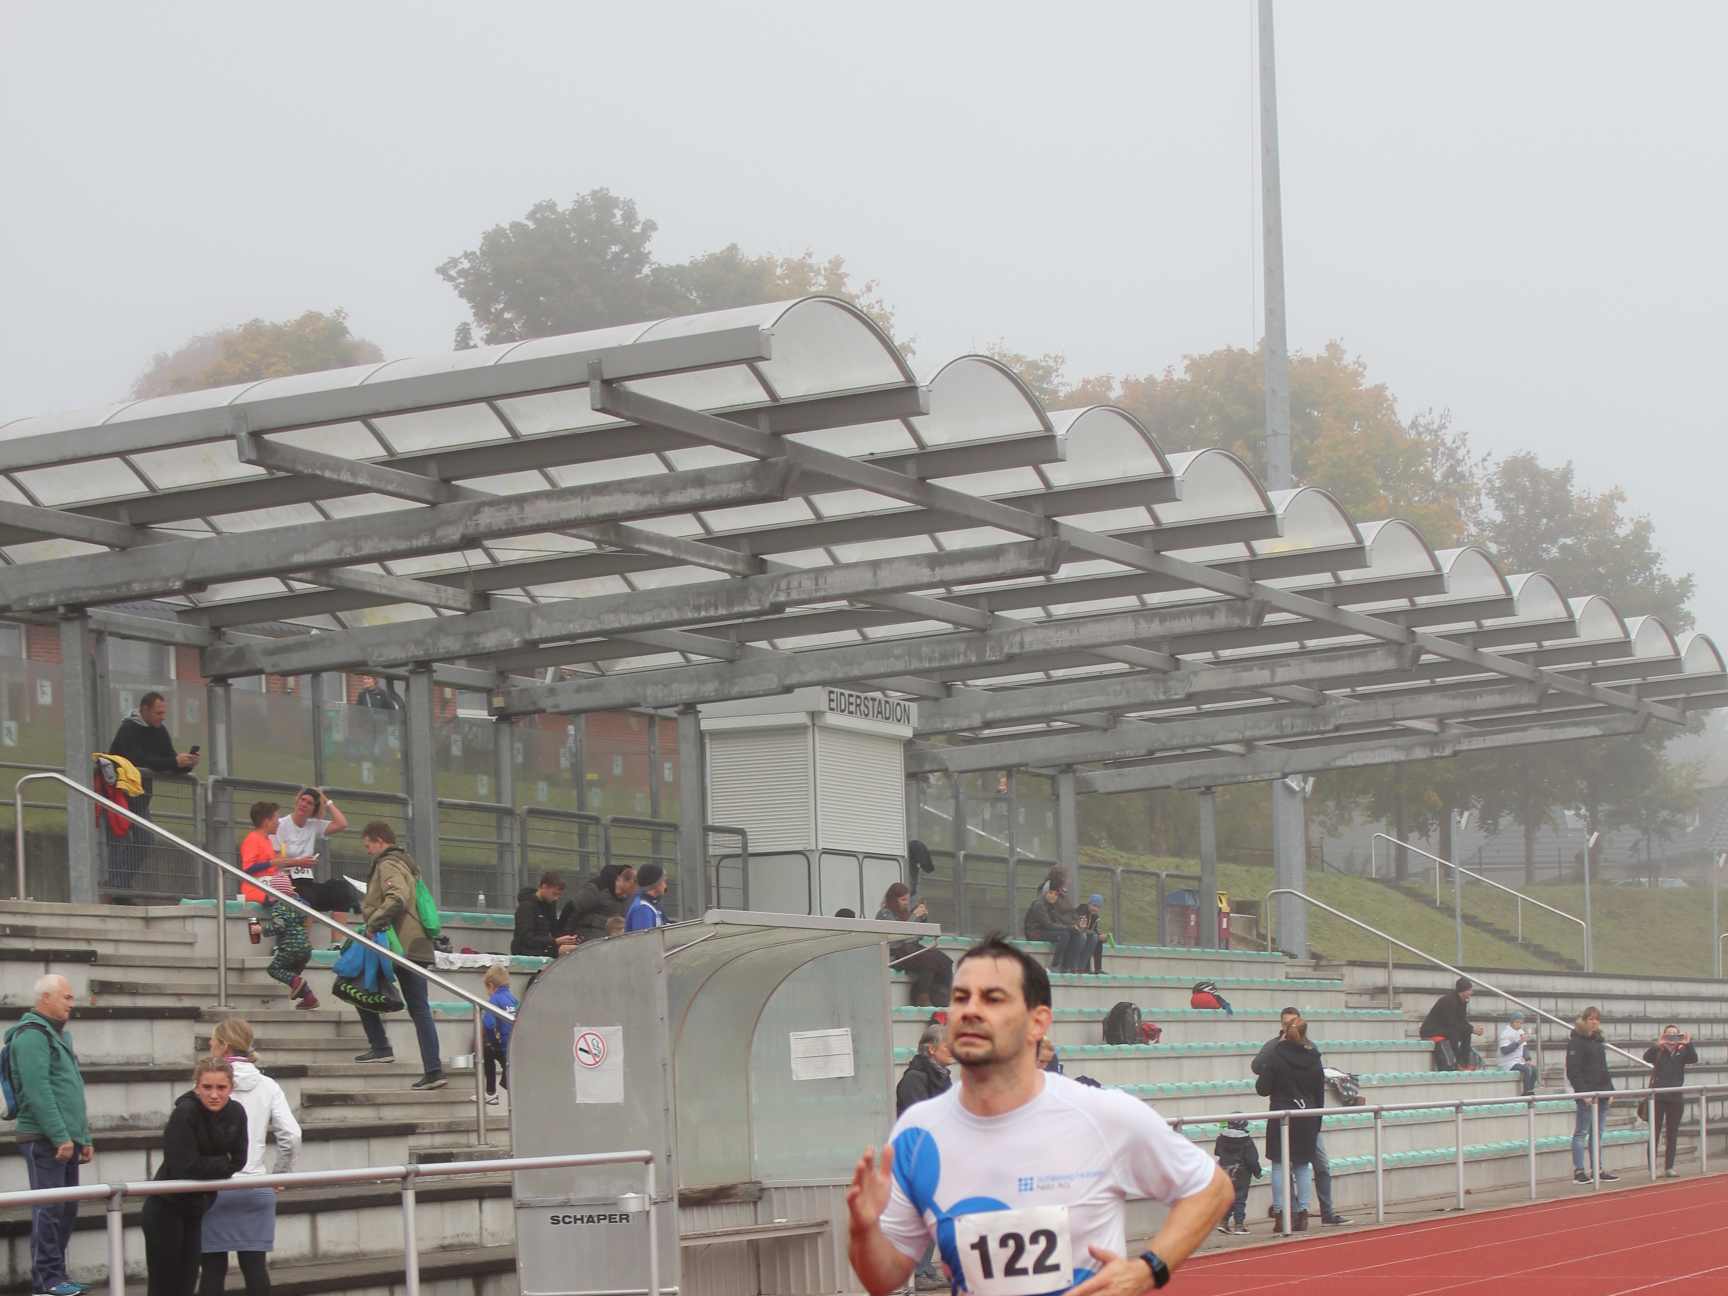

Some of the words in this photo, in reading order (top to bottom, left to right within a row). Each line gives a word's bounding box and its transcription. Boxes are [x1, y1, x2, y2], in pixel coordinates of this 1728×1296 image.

[828, 690, 910, 724] EIDERSTADION
[550, 1213, 630, 1225] SCHÄPER
[970, 1229, 1061, 1279] 122
